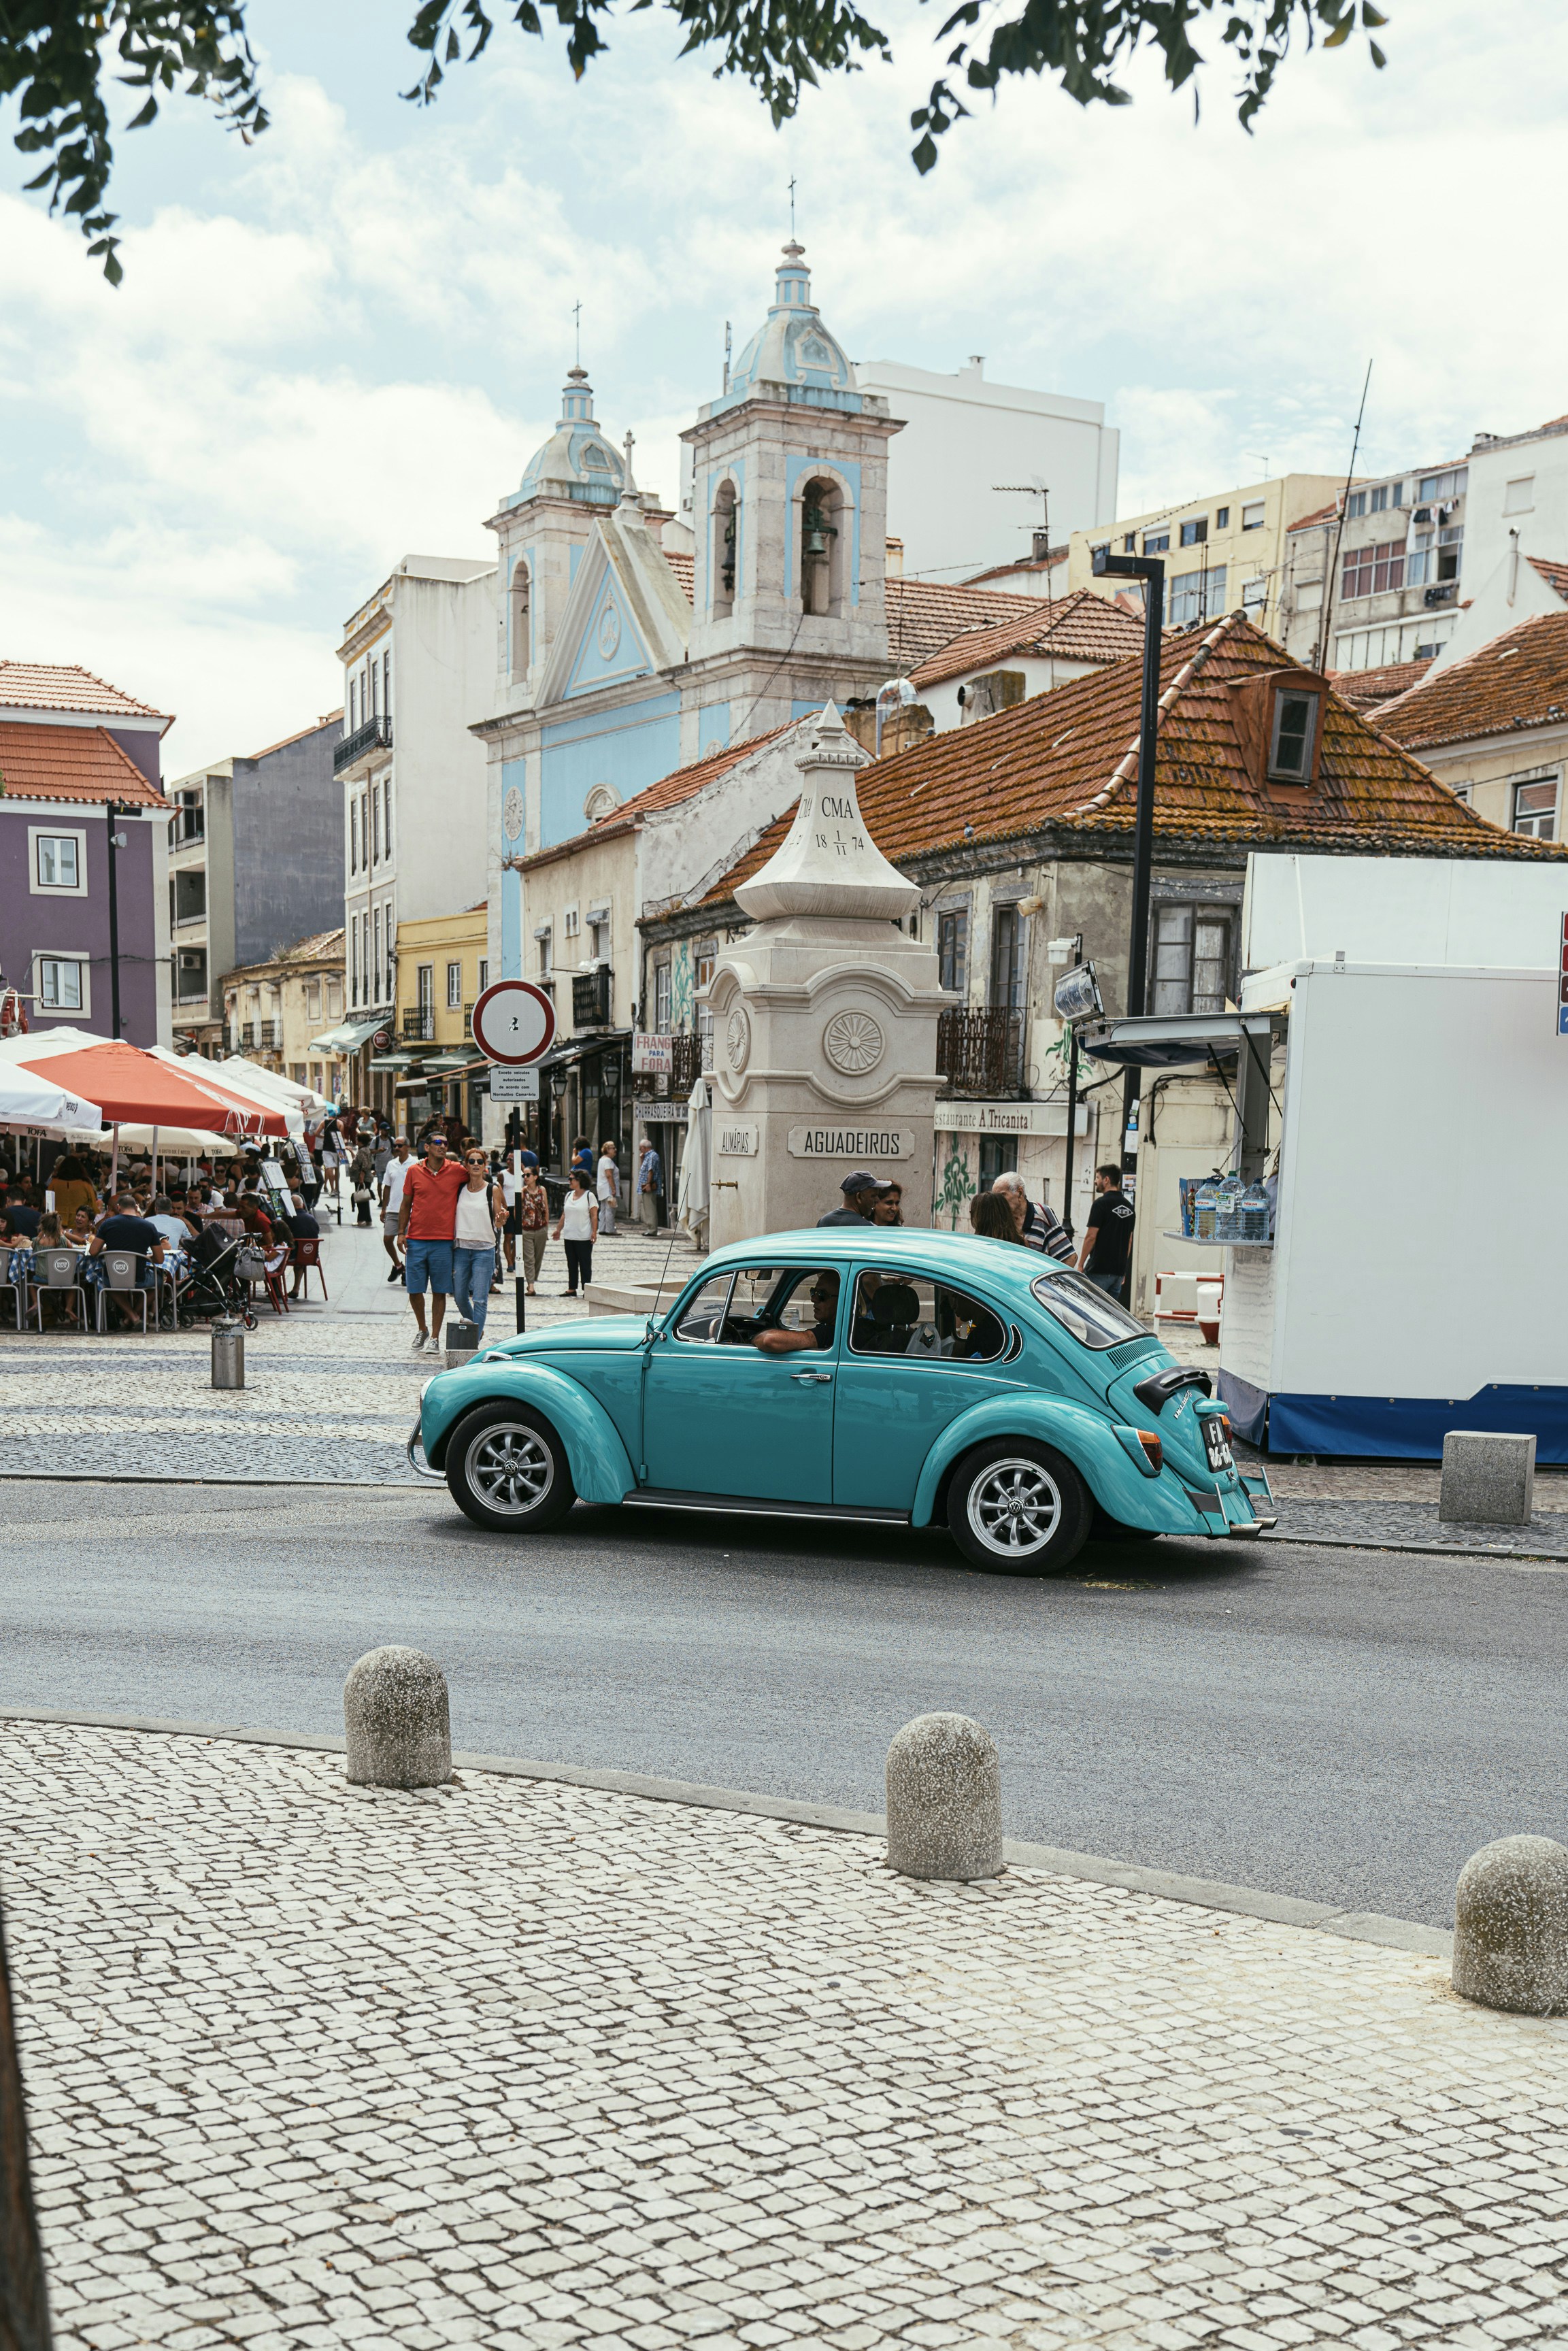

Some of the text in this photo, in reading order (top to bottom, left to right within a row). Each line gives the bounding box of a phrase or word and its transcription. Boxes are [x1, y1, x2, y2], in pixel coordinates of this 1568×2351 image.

[821, 796, 854, 818] CMA
[816, 834, 827, 848] 18
[852, 836, 864, 850] 74
[641, 1057, 671, 1071] FORA
[635, 1105, 675, 1119] CHURRASQUEIRA
[934, 1108, 1029, 1130] estaurante A Tricanita
[26, 1127, 48, 1137] TOFA
[722, 1128, 749, 1153] ALIMÁRIAS
[804, 1131, 900, 1154] AGUADEIROS
[118, 1145, 133, 1153] TOFA
